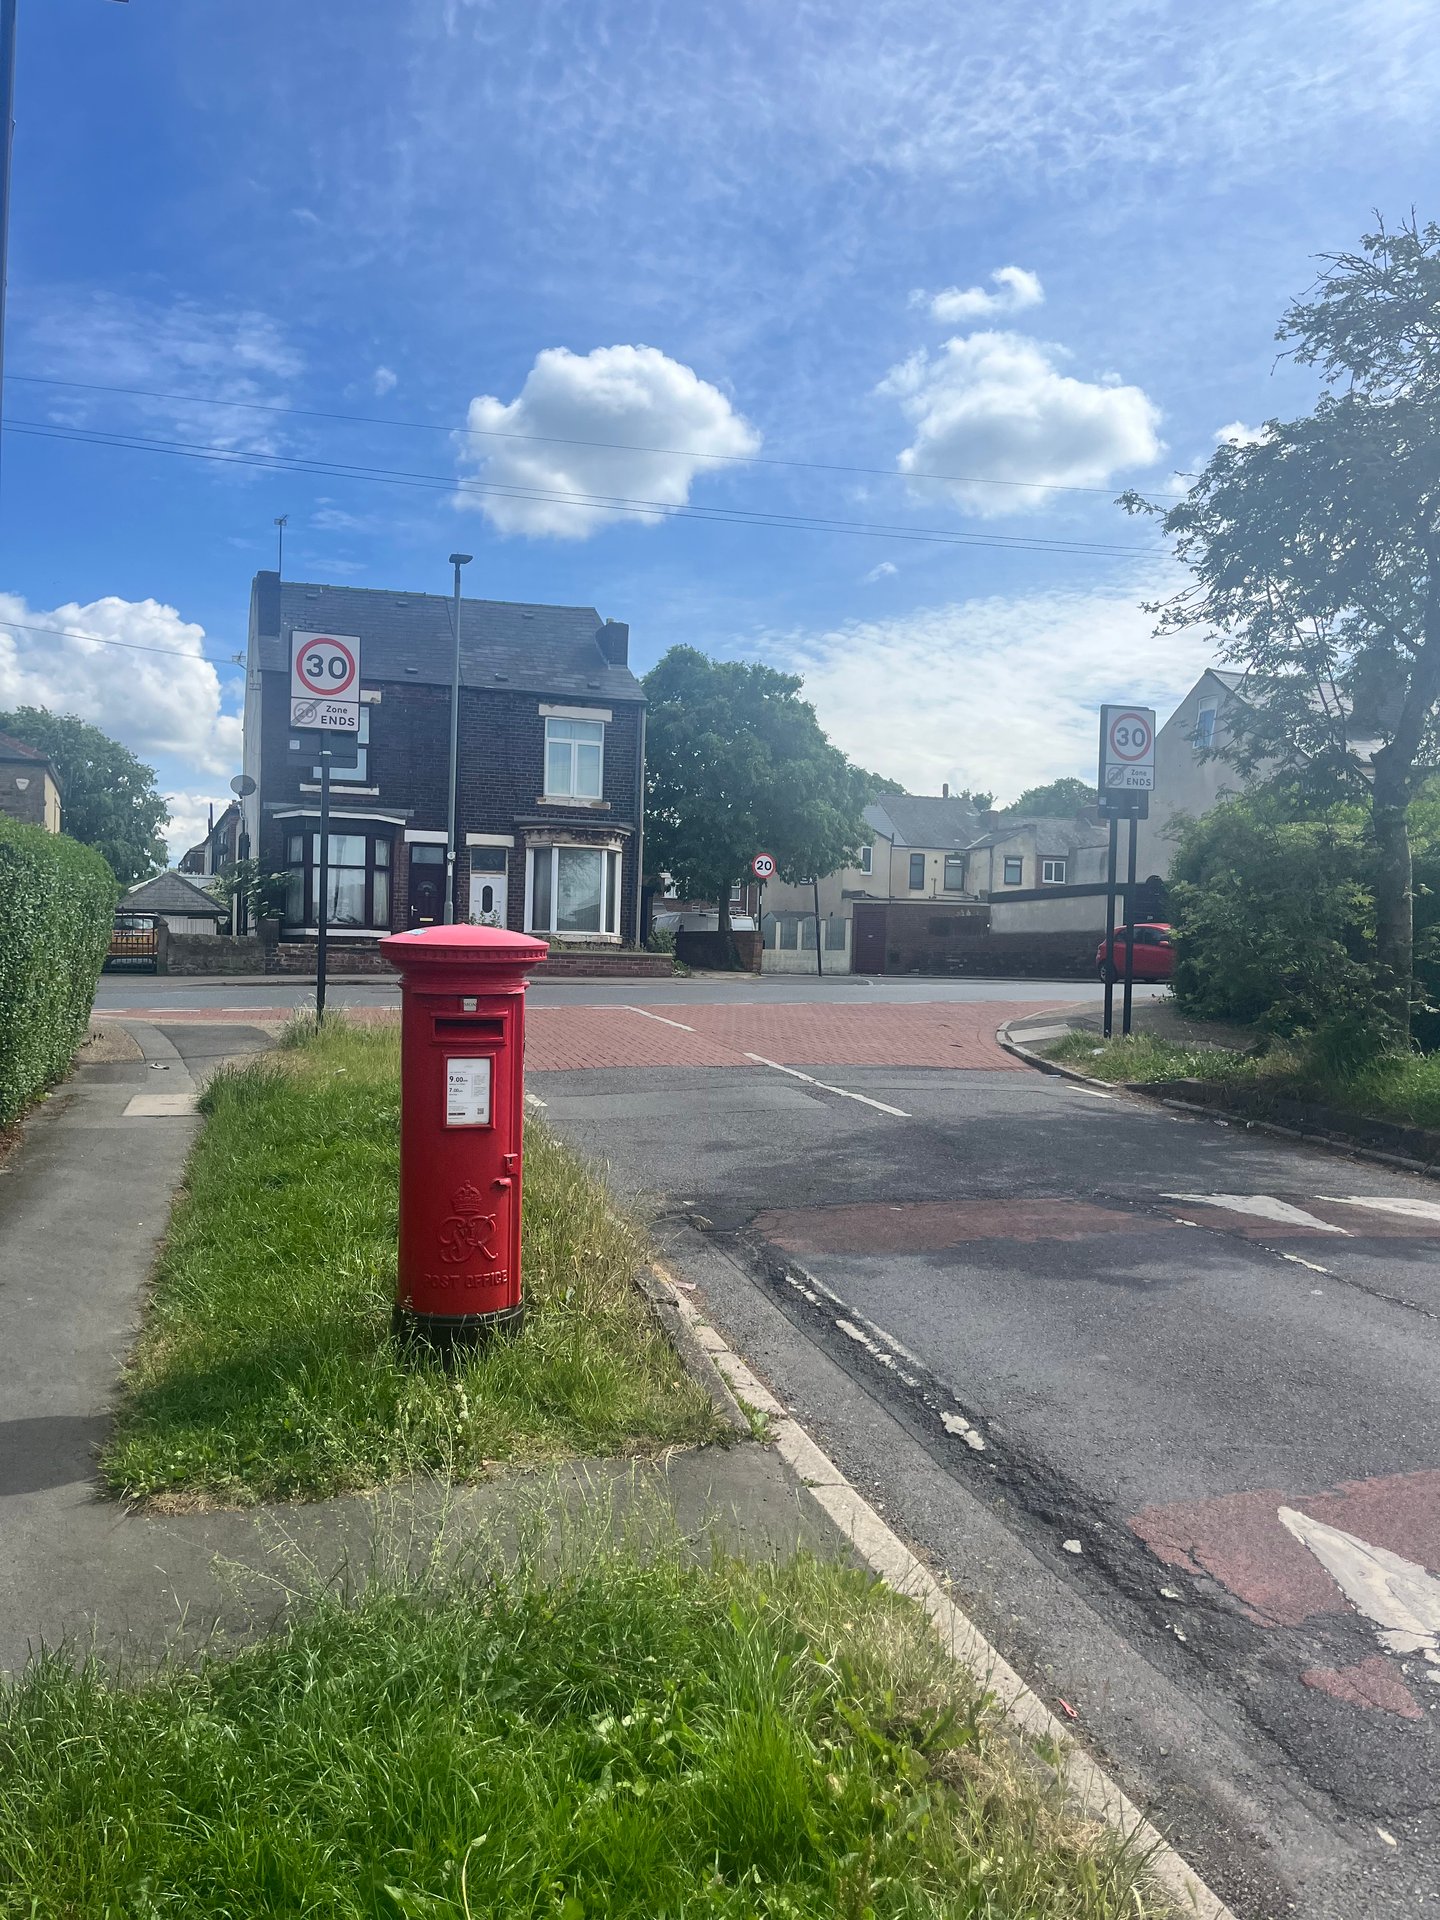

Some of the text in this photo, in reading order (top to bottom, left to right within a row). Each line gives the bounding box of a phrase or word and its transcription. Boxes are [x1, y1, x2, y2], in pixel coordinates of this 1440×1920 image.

[306, 654, 348, 679] 30
[326, 705, 348, 714] Zone
[321, 715, 355, 726] ENDS
[1116, 727, 1146, 747] 30
[1126, 777, 1151, 786] ENDS
[756, 860, 772, 870] 20
[423, 1269, 508, 1289] POST OFFICE
